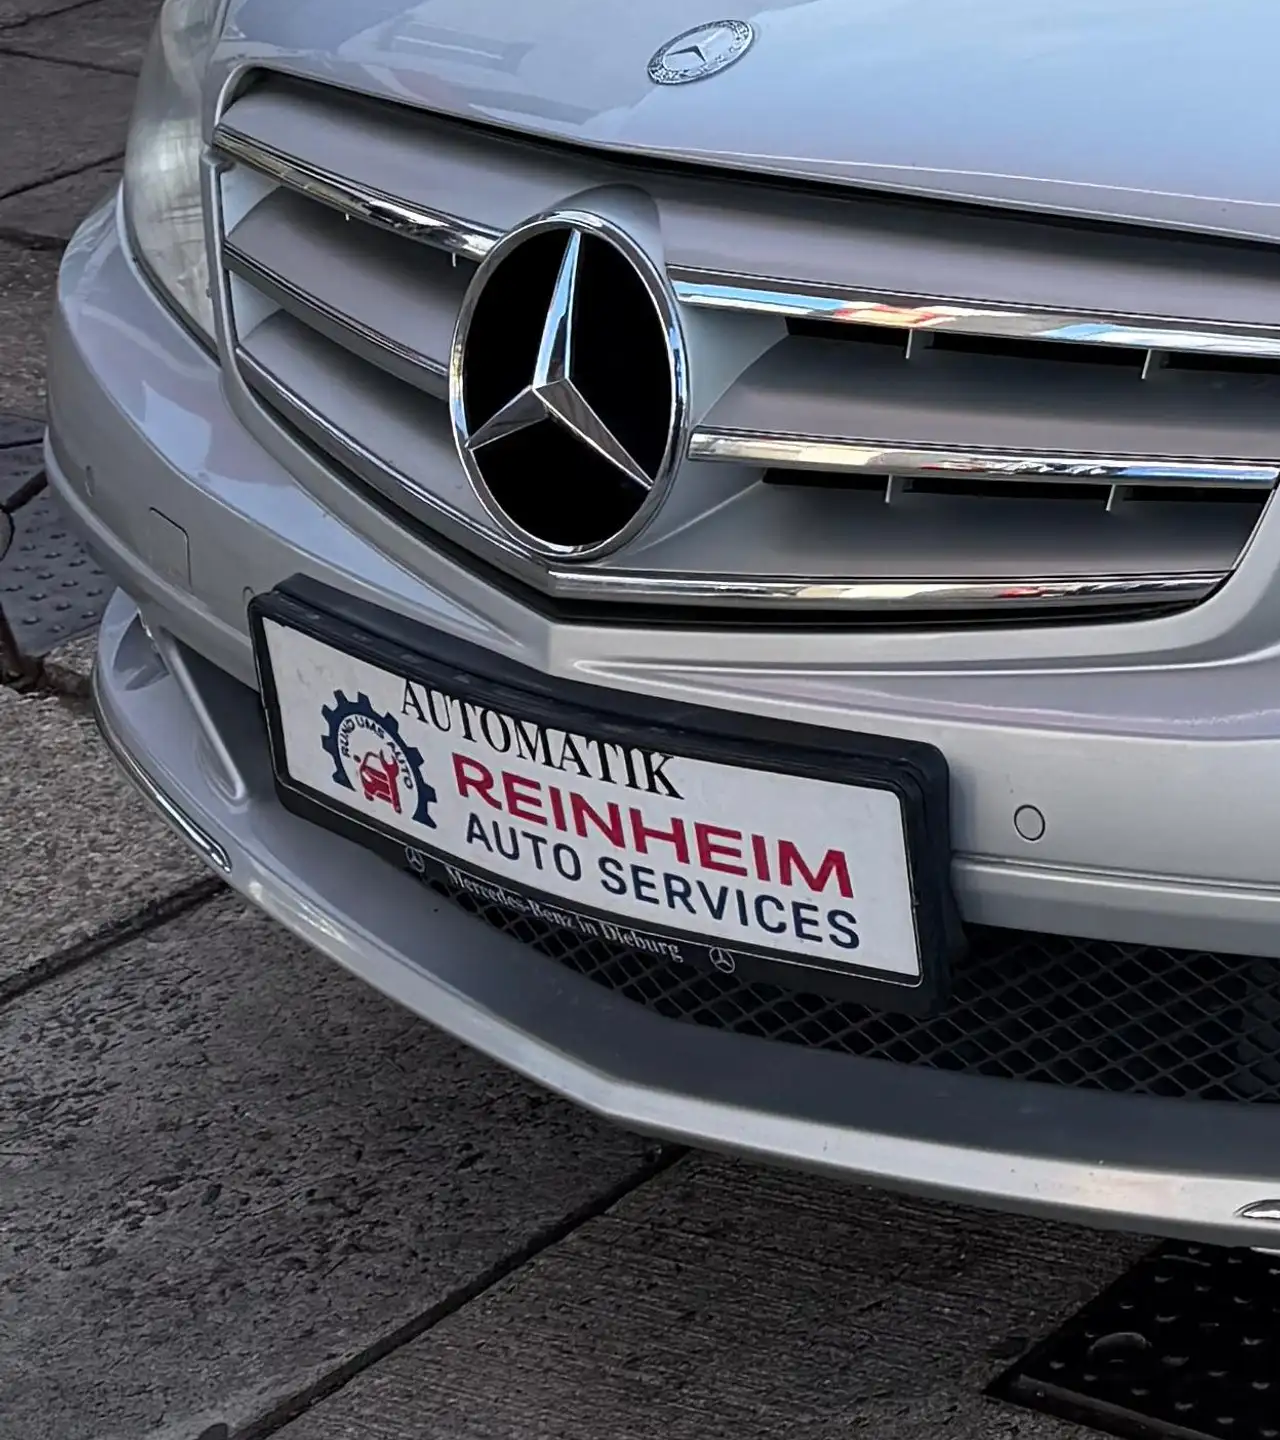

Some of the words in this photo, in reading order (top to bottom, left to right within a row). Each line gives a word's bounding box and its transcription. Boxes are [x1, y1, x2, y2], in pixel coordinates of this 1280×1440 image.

[340, 717, 356, 758] RUND
[354, 714, 385, 740] UMS
[387, 741, 414, 790] AUTO
[401, 679, 684, 799] AUTOMATIK
[453, 752, 854, 899] REINHEIM
[466, 813, 582, 883] AUTO
[599, 857, 860, 950] SERVICES
[446, 864, 576, 928] Mercedes-Benz
[578, 911, 599, 935] in
[601, 922, 685, 962] Dieburg
